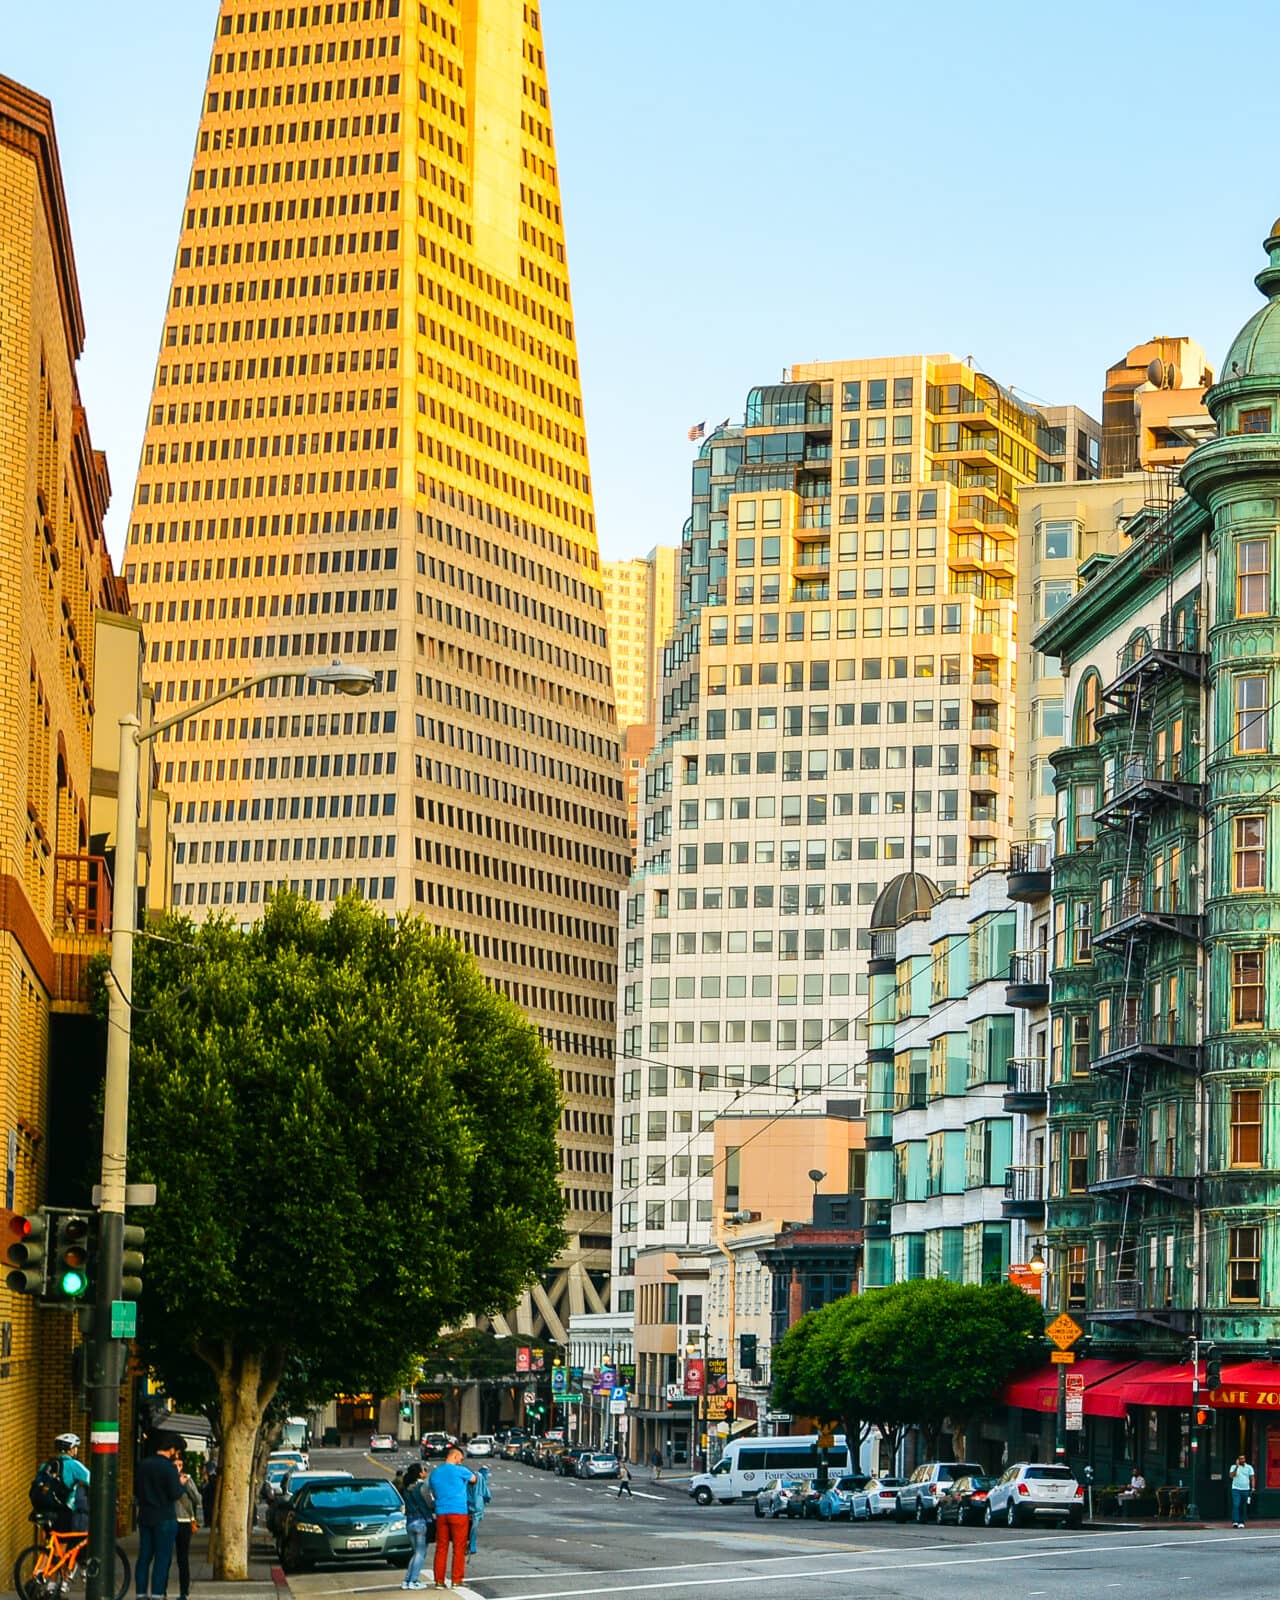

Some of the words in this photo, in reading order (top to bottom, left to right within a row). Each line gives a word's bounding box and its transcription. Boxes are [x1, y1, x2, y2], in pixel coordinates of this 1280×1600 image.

[1209, 1391, 1249, 1404] CAFE
[765, 1471, 783, 1480] Four
[787, 1470, 816, 1480] Season
